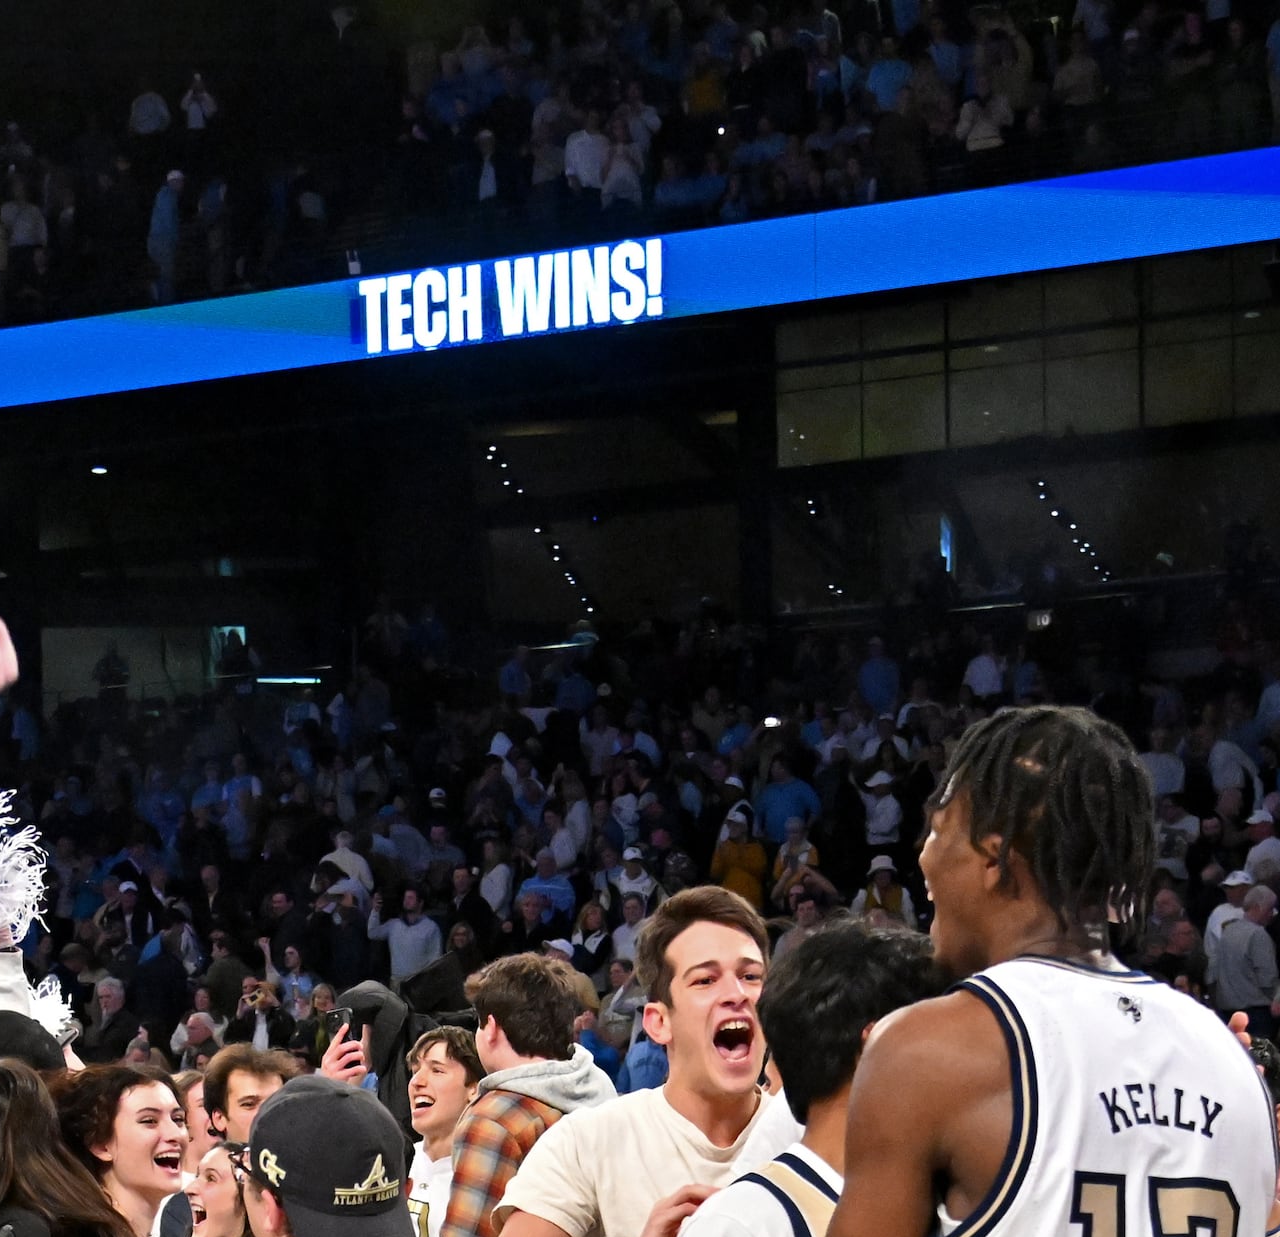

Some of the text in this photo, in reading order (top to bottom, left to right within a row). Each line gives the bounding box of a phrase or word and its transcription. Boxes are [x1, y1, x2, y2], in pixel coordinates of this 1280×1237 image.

[359, 238, 664, 354] TECH WINS!
[1098, 1083, 1223, 1138] KELLY
